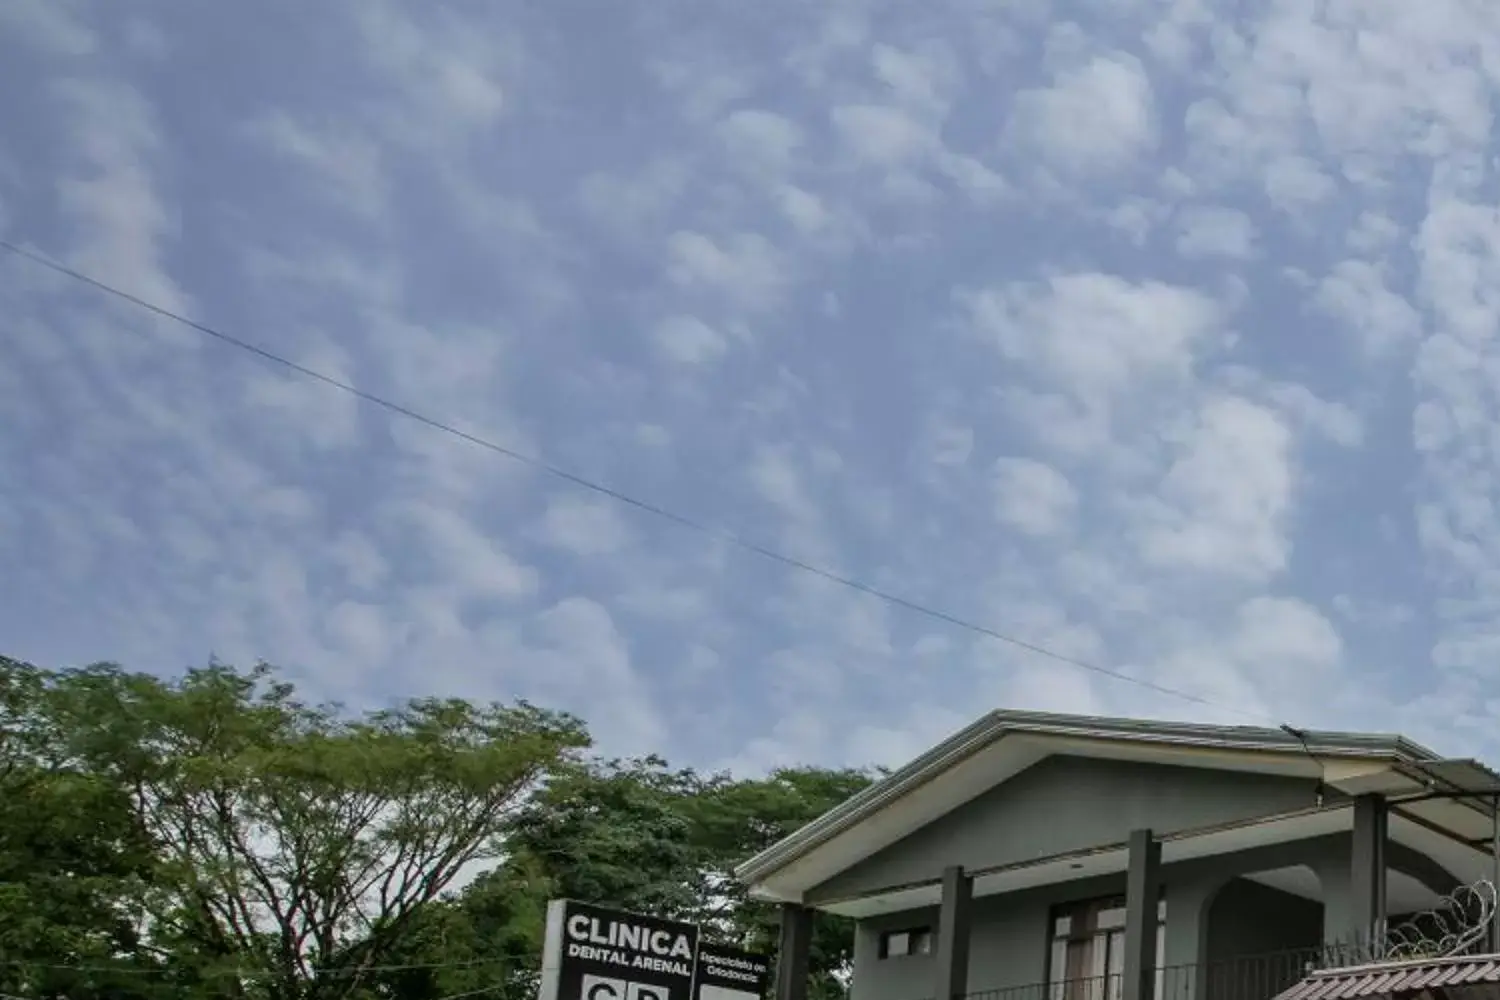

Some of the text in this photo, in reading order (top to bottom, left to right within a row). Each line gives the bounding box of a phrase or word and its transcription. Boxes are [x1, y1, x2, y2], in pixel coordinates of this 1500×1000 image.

[567, 914, 693, 960] CLINICA
[568, 943, 692, 977] DENTAL ARENAL
